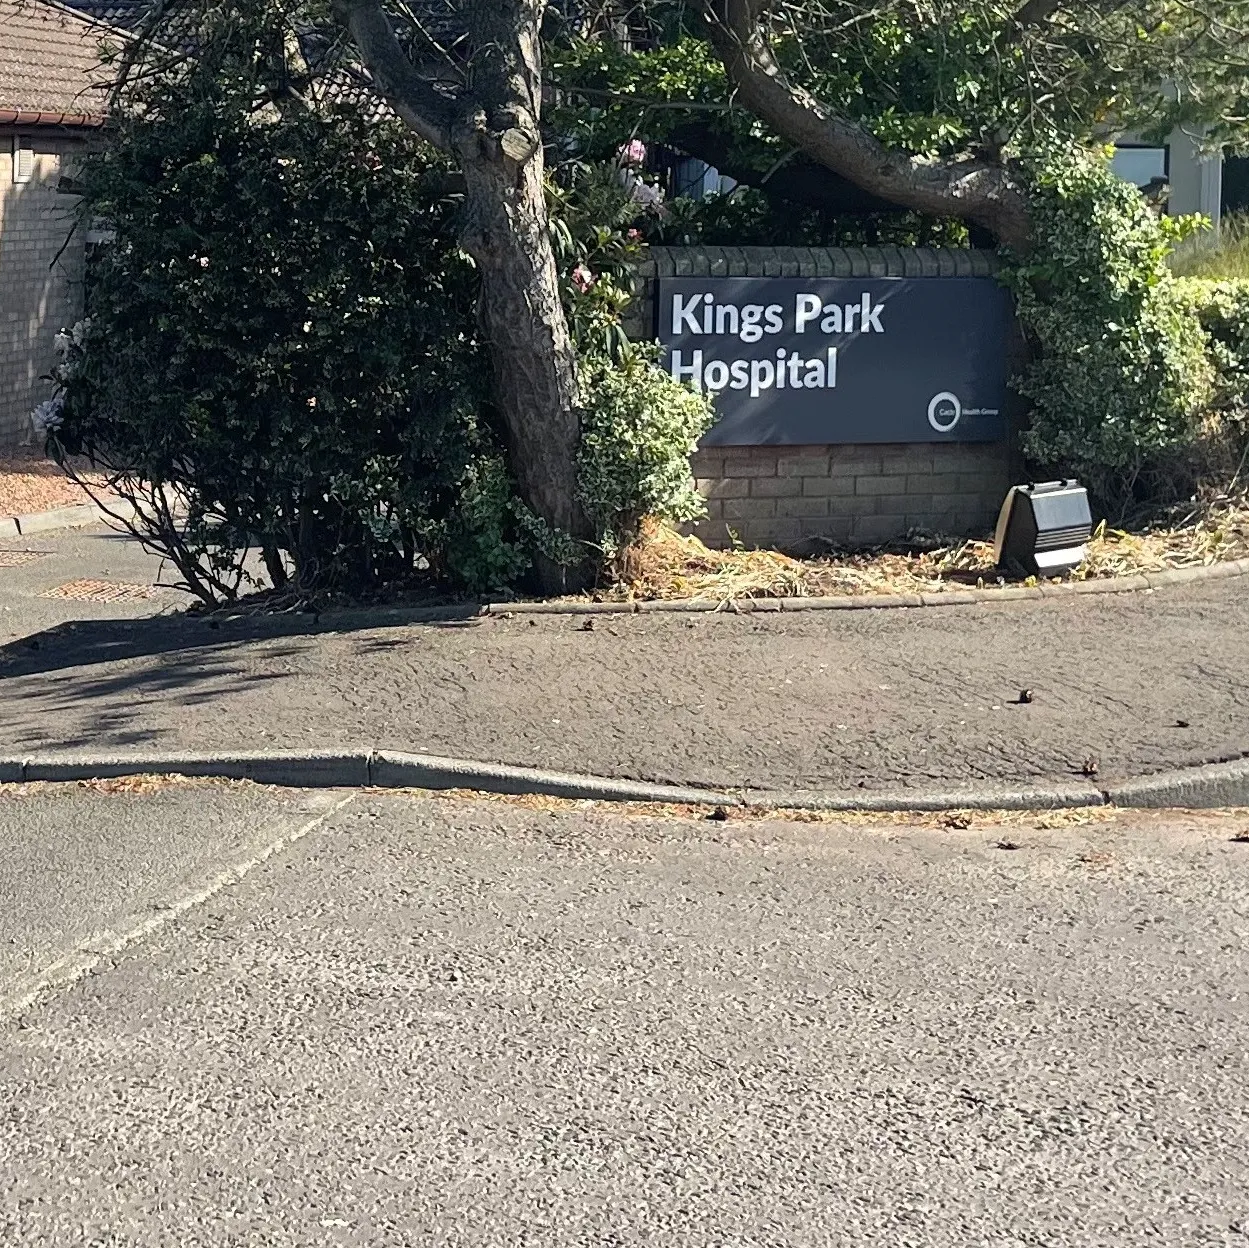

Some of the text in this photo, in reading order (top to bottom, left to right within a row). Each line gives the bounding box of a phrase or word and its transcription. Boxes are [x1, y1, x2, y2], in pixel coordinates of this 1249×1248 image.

[672, 293, 885, 343] Kings Park
[672, 347, 838, 397] Hospital
